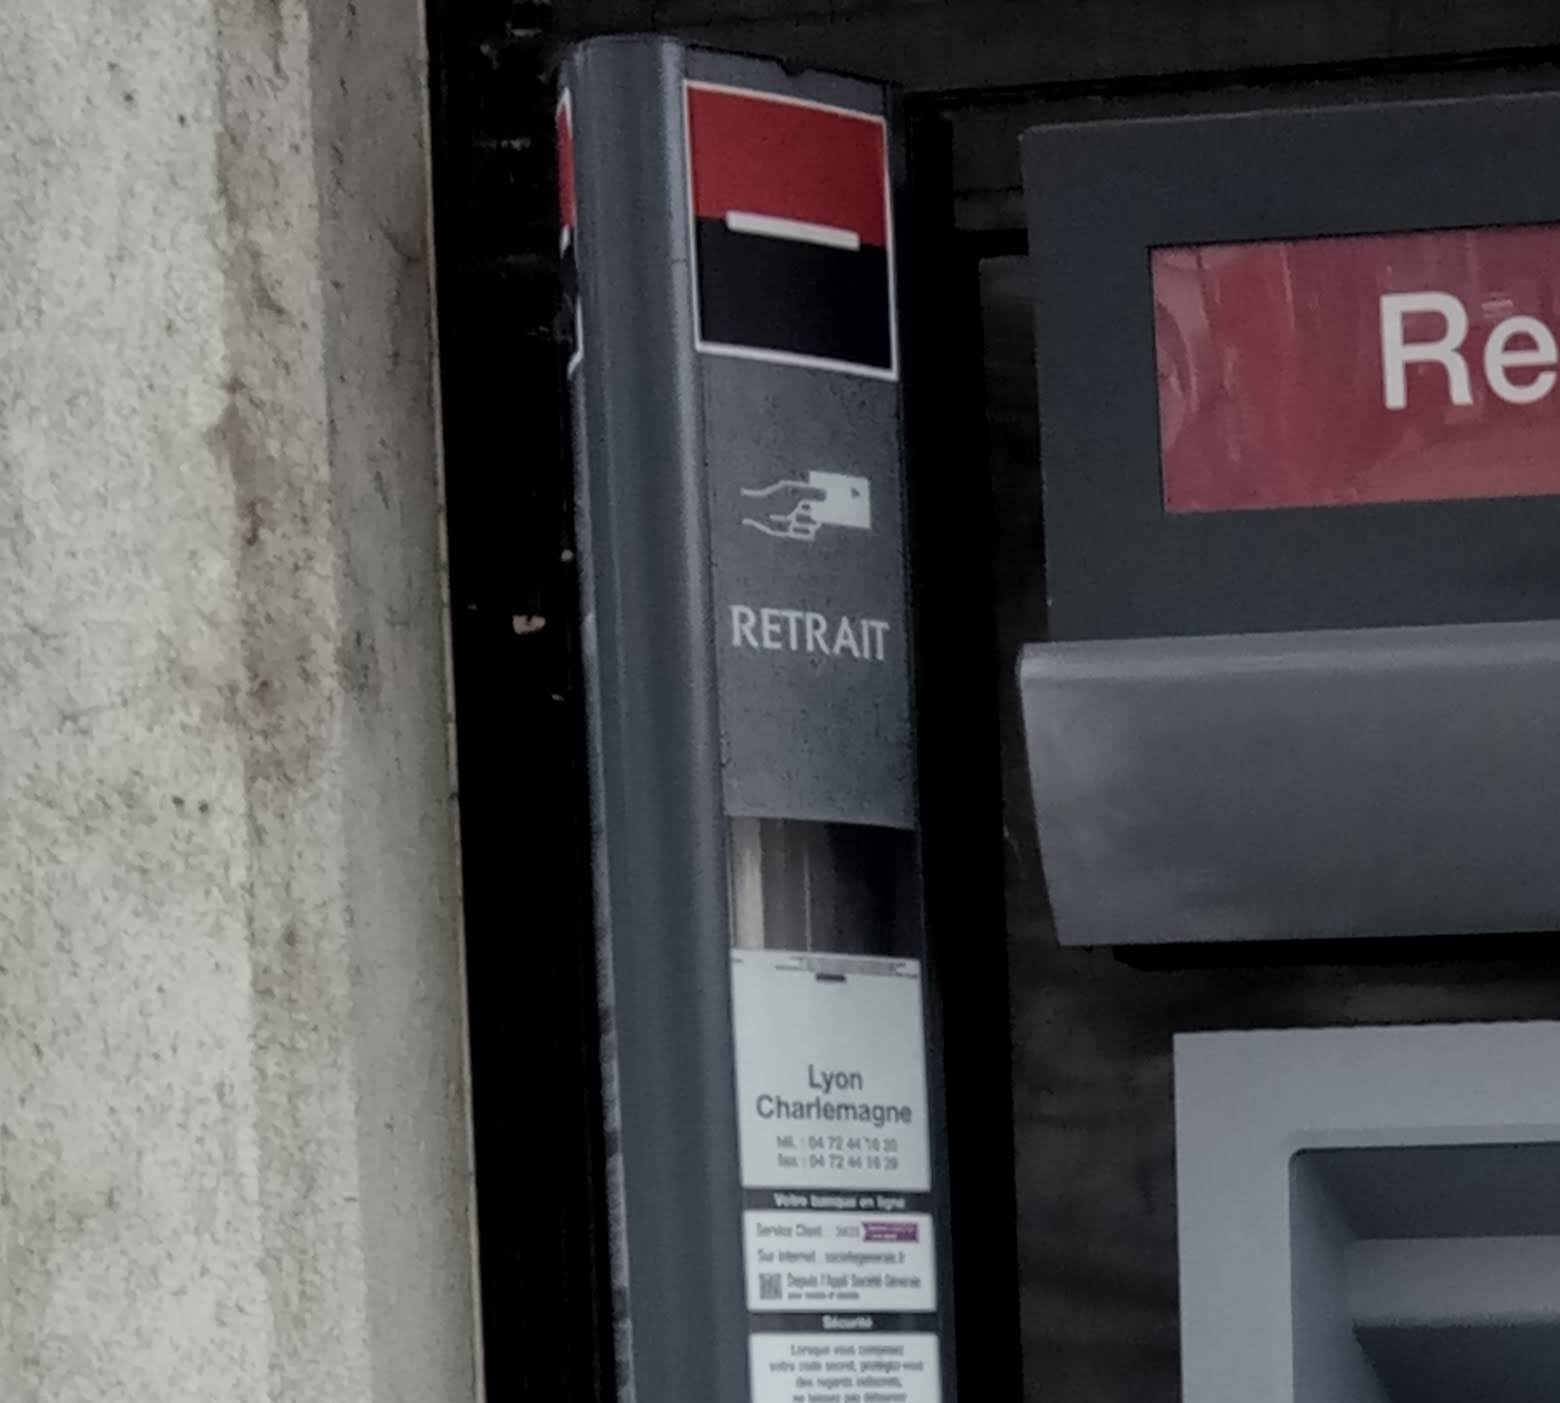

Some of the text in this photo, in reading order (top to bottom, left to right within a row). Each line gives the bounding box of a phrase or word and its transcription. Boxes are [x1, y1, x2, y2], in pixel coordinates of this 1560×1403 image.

[730, 604, 890, 662] RETRAIT
[808, 1064, 863, 1094] Lyon
[756, 1094, 912, 1127] Charlemagne
[827, 1136, 843, 1150] 72
